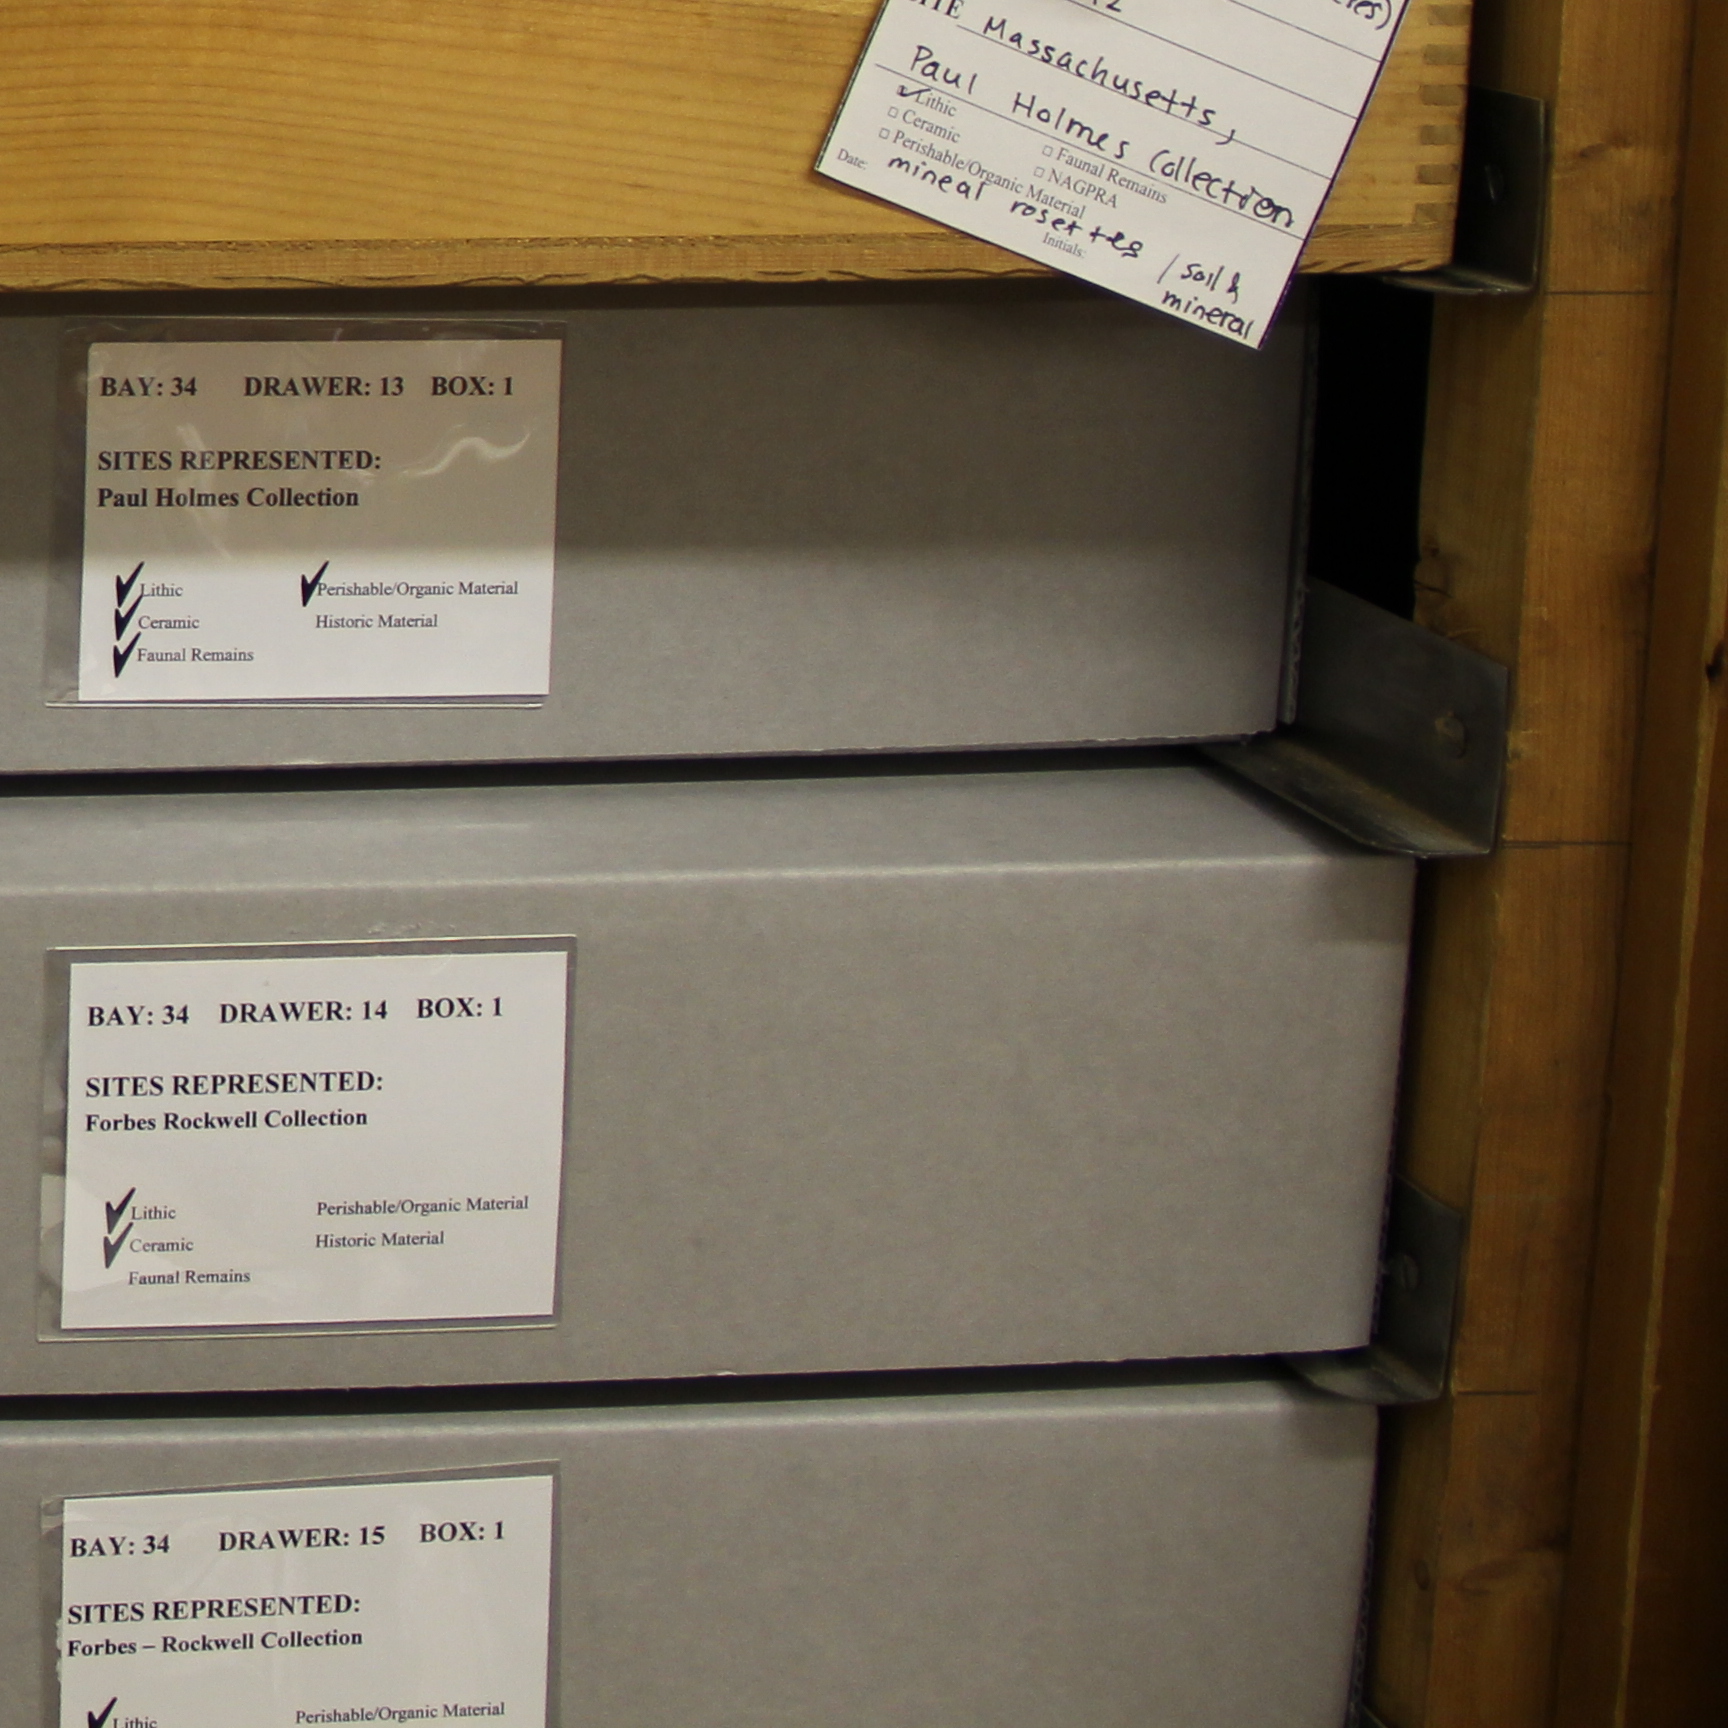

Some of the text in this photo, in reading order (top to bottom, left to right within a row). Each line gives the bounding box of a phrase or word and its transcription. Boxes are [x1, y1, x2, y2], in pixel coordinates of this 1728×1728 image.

[910, 44, 979, 96] Paul
[1011, 92, 1131, 162] Holmes
[1048, 168, 1120, 210] NAGPRA
[1161, 286, 1255, 339] mineral
[100, 376, 514, 397] BAY: 34 DRAWER: 13 BOX: 1
[97, 450, 382, 471] SITES REPRESENTED:
[97, 487, 360, 508] Paul Holmes Collection
[87, 996, 503, 1028] BAY: 34 DRAWER: 14 BOX: 1
[85, 1071, 384, 1099] SITES REPRESENTED:
[85, 1108, 368, 1133] Forbes Rockwell Collection
[317, 1196, 529, 1220] Perishable/Organic Material
[70, 1521, 505, 1559] BAY: 34 DRAWER: 15 BOX: 1
[67, 1593, 361, 1626] SITES REPRESENTED:
[67, 1637, 138, 1658] Forbes
[161, 1633, 254, 1654] Rockwell
[261, 1629, 363, 1650] Collection
[295, 1702, 505, 1725] Perishable/Organic Material
